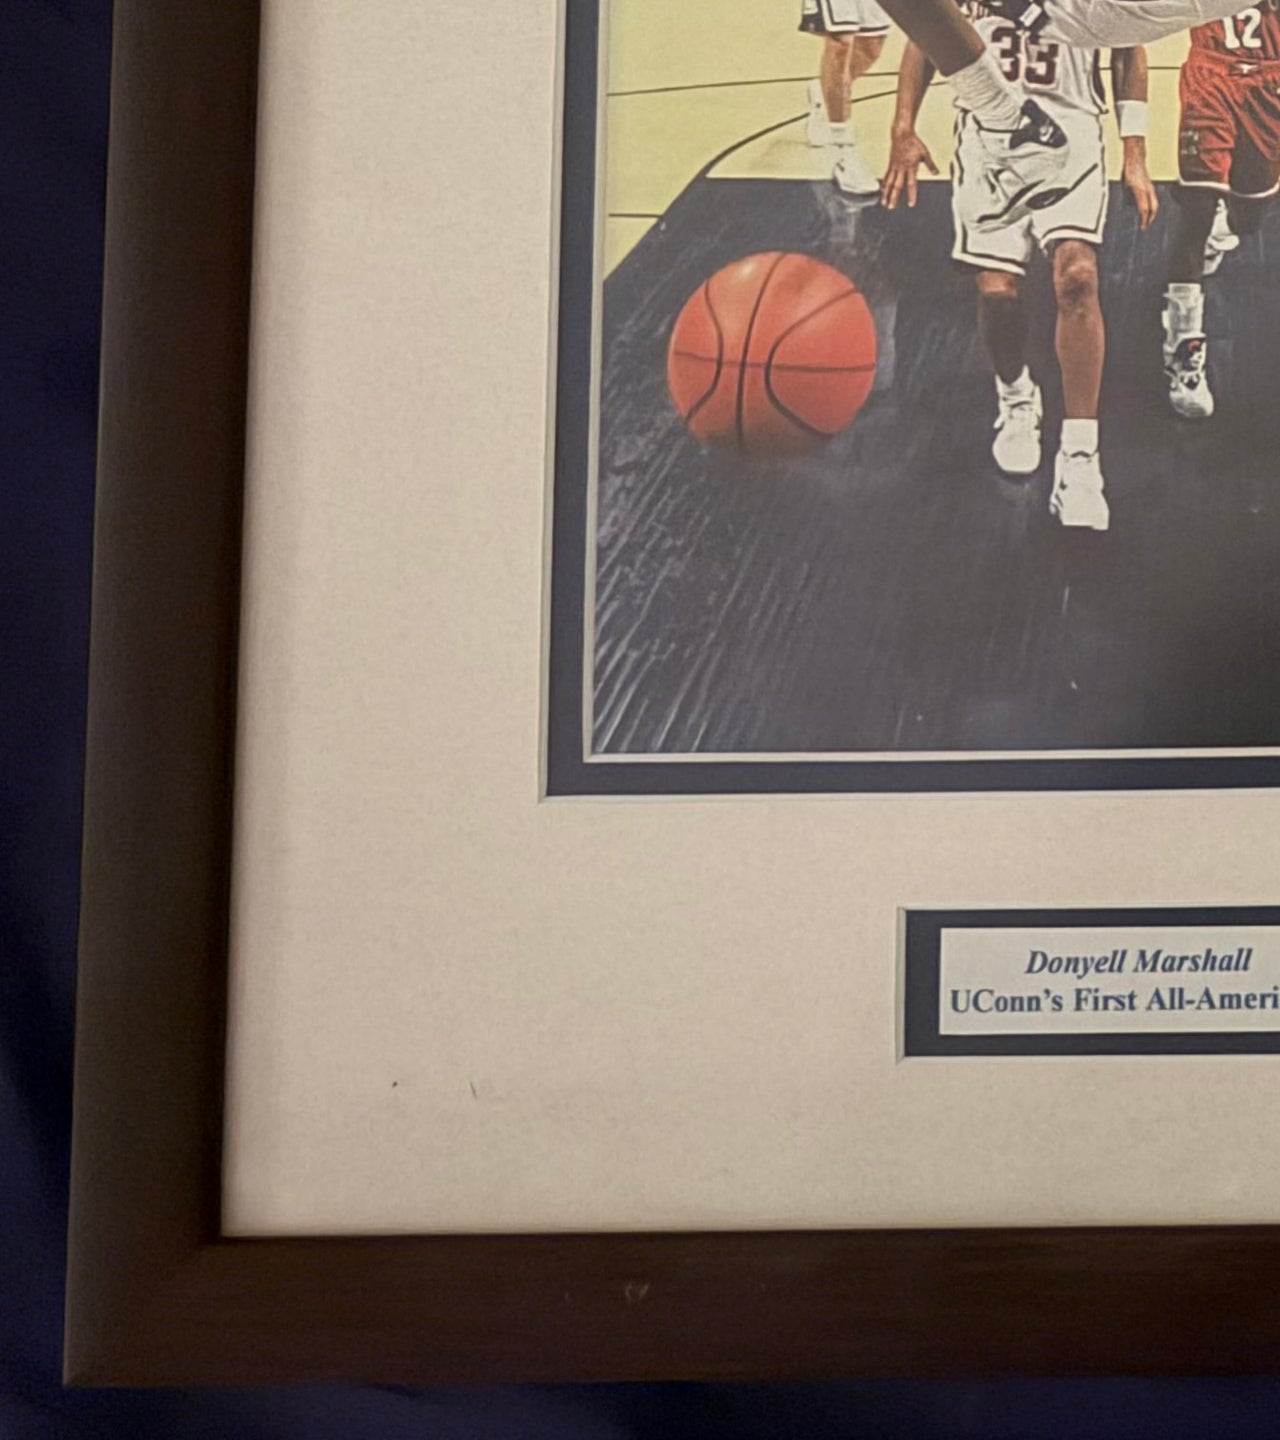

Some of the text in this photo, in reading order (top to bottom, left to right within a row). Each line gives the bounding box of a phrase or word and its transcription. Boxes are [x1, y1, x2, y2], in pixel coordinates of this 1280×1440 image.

[1221, 7, 1263, 50] 12
[991, 26, 1060, 89] 33
[1025, 947, 1253, 980] Donyell Marshall
[1073, 987, 1138, 1012] First
